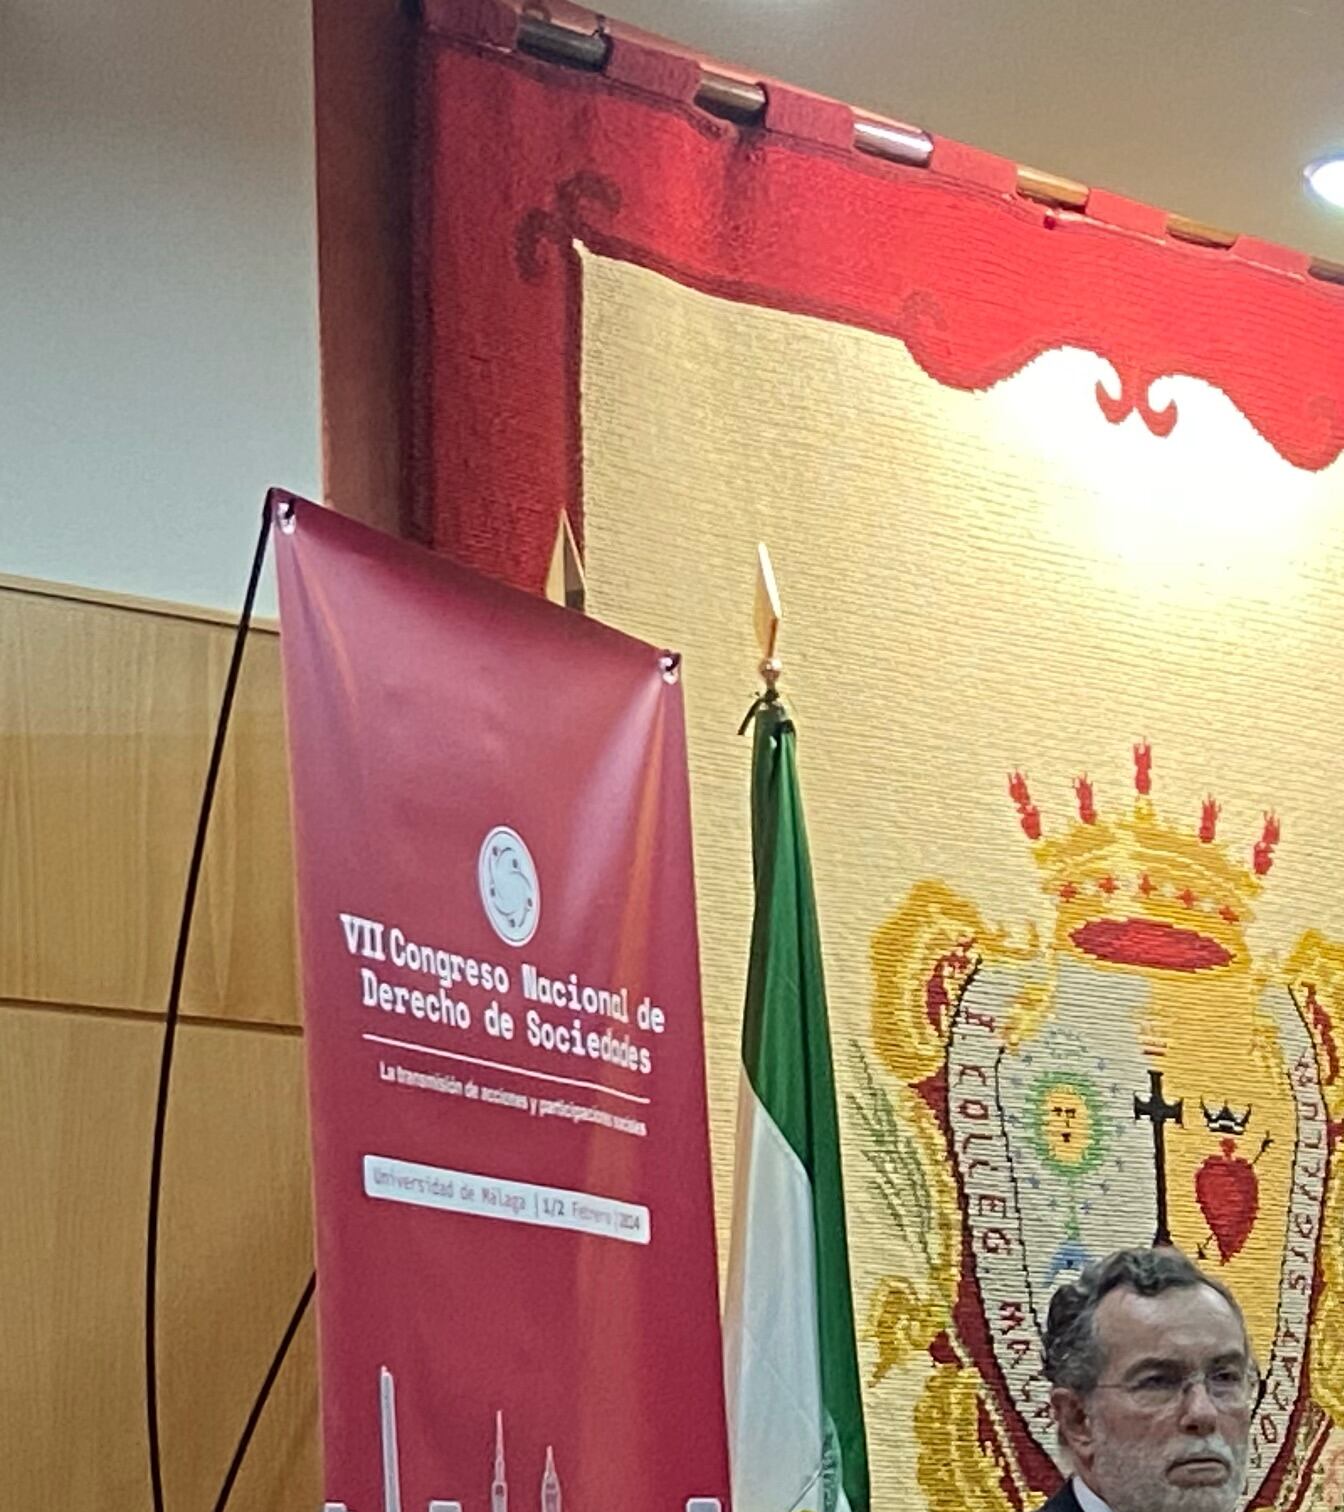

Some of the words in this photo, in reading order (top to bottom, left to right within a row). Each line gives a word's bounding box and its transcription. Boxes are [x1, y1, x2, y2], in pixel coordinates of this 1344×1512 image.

[339, 912, 386, 961] VII
[389, 927, 510, 994] Congreso
[521, 963, 629, 1024] Nacional
[637, 996, 665, 1033] de
[361, 967, 471, 1029] Derecho
[484, 1001, 514, 1040] de
[526, 1009, 652, 1074] Sociedades
[460, 1182, 475, 1201] de
